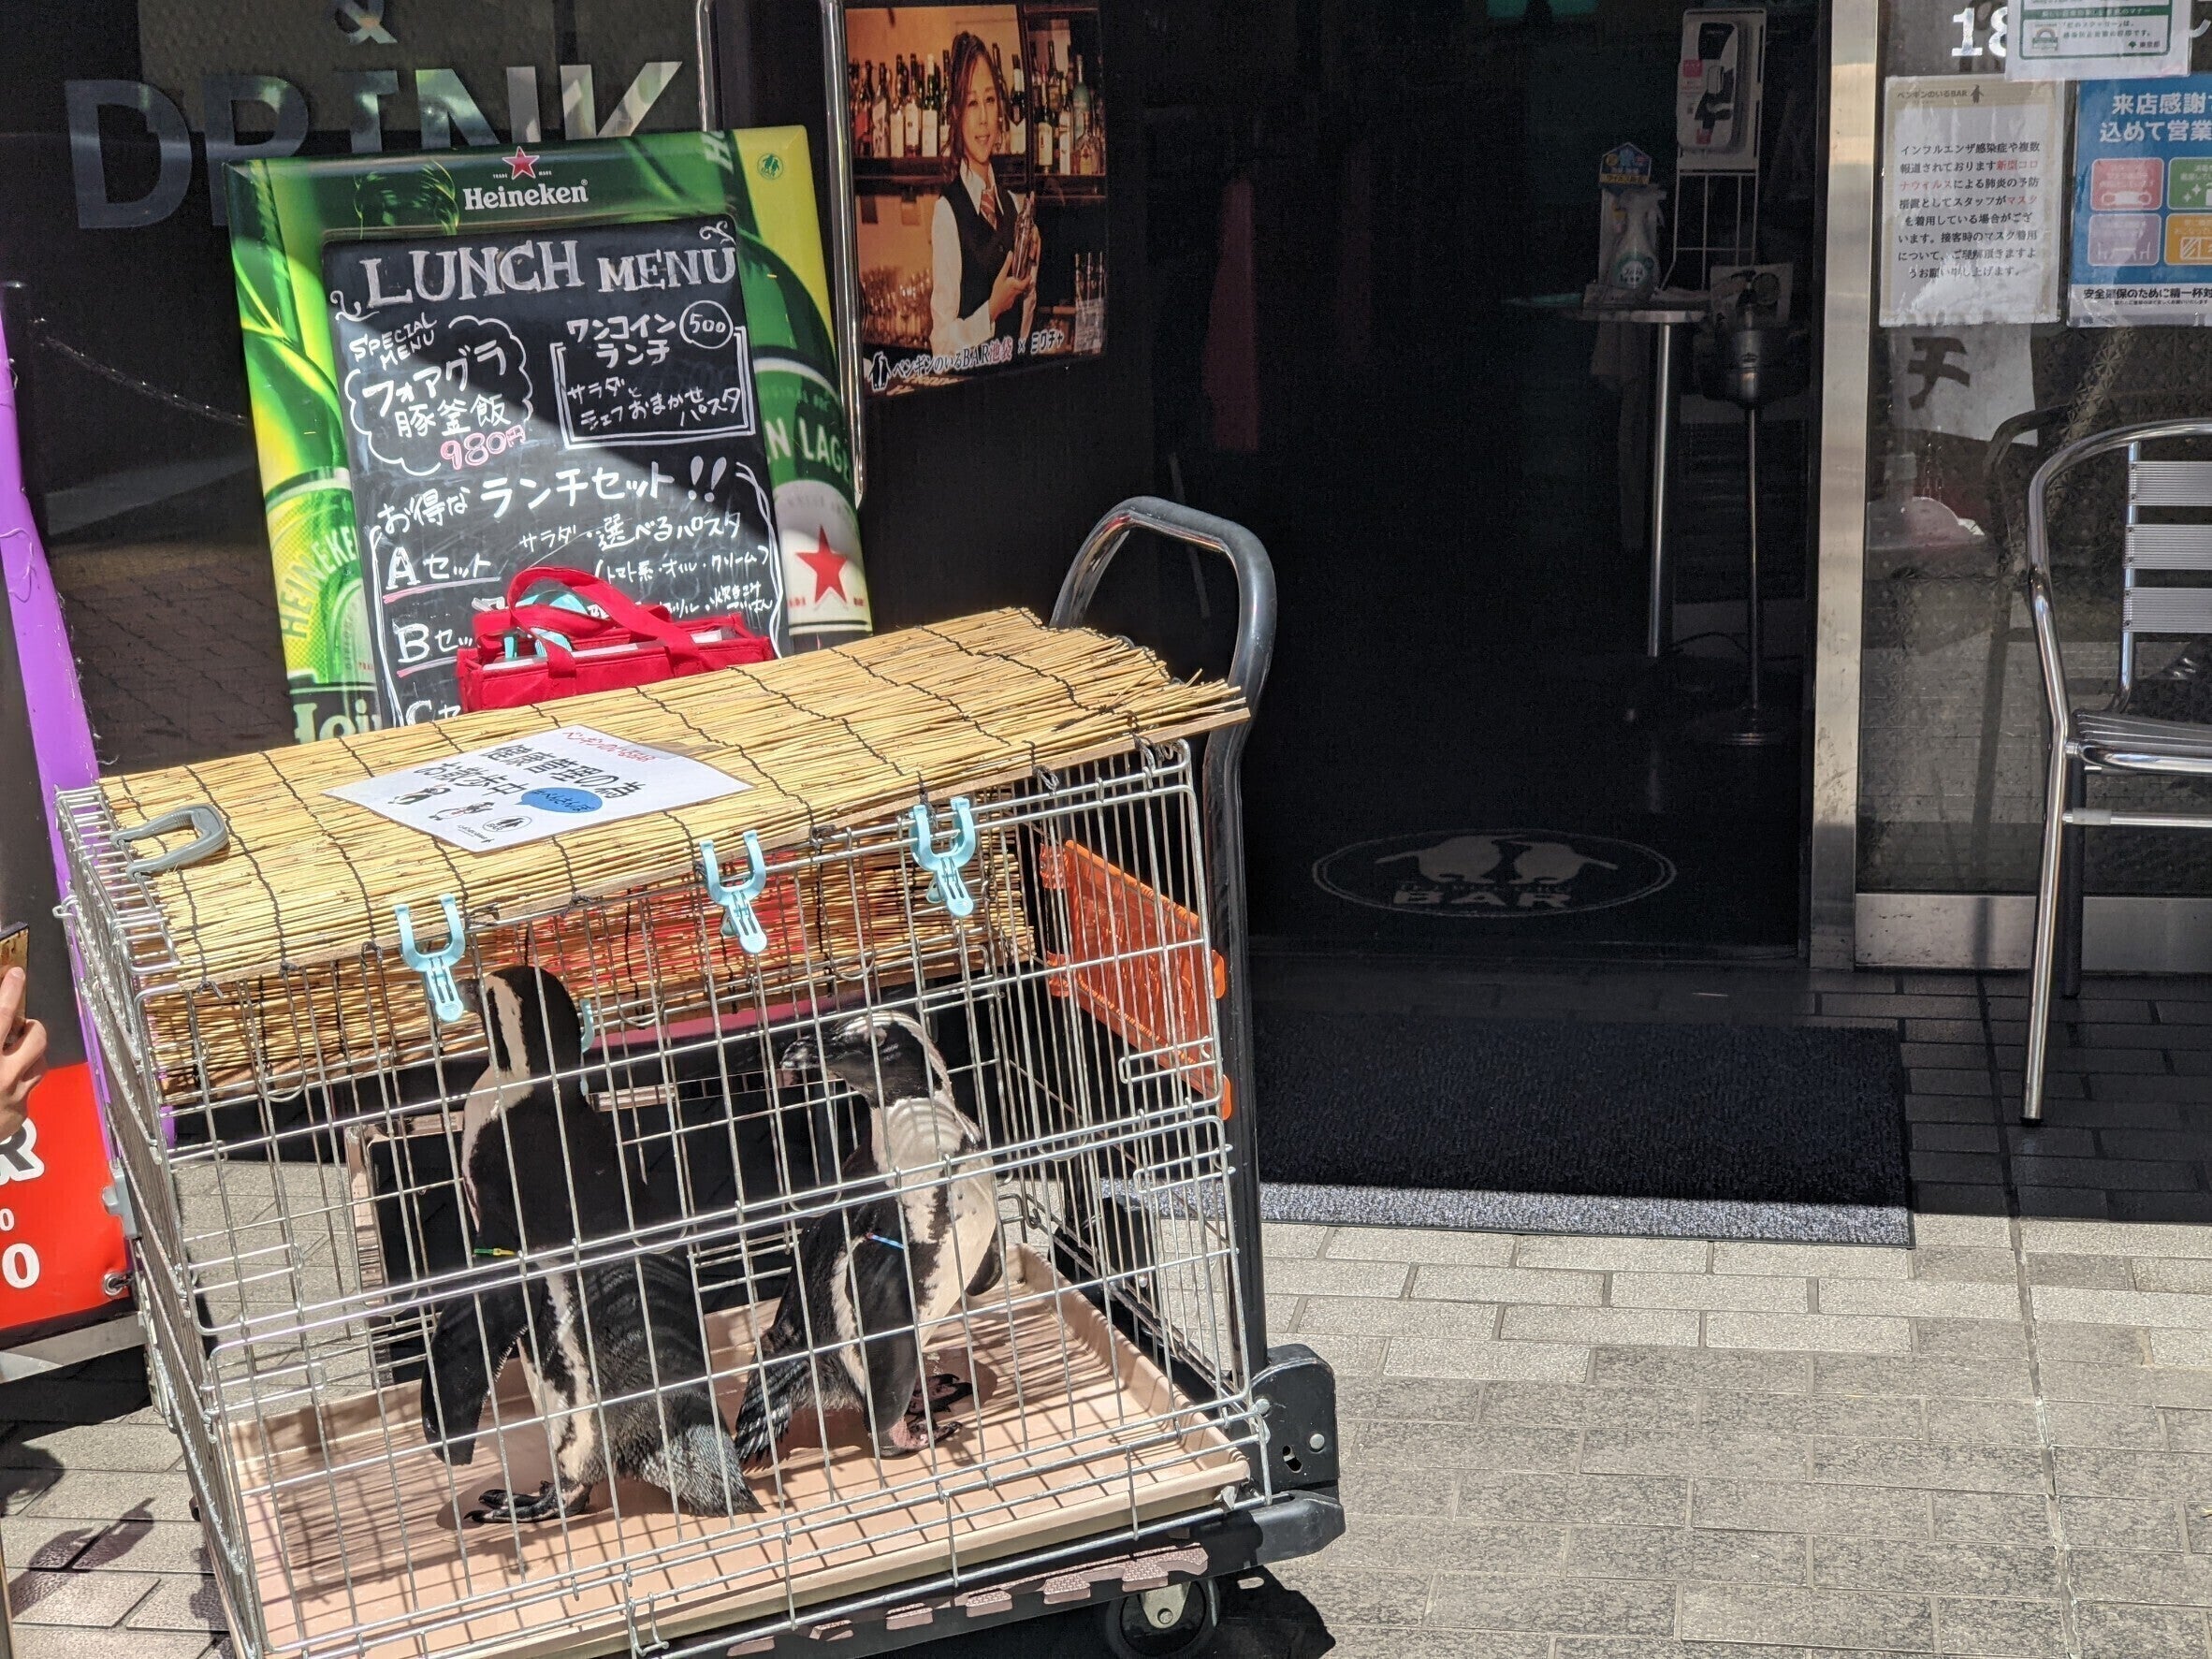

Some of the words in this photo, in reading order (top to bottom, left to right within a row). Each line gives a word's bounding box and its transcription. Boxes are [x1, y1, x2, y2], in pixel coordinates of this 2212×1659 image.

[462, 183, 589, 211] Heineken
[359, 240, 586, 309] LUNCH
[597, 247, 736, 293] MENU
[349, 312, 438, 363] SPECIAL
[566, 313, 677, 343] ワンコイン
[689, 313, 726, 334] 500
[380, 330, 434, 371] MENU
[596, 339, 671, 369] ランチ
[892, 336, 1012, 378] ペンギンのいるBAR池袋
[362, 339, 507, 417] フォアグラ
[567, 376, 643, 404] サラダと
[440, 424, 527, 471] 980円
[413, 762, 530, 796] お散歩中
[1393, 889, 1571, 908] BAR
